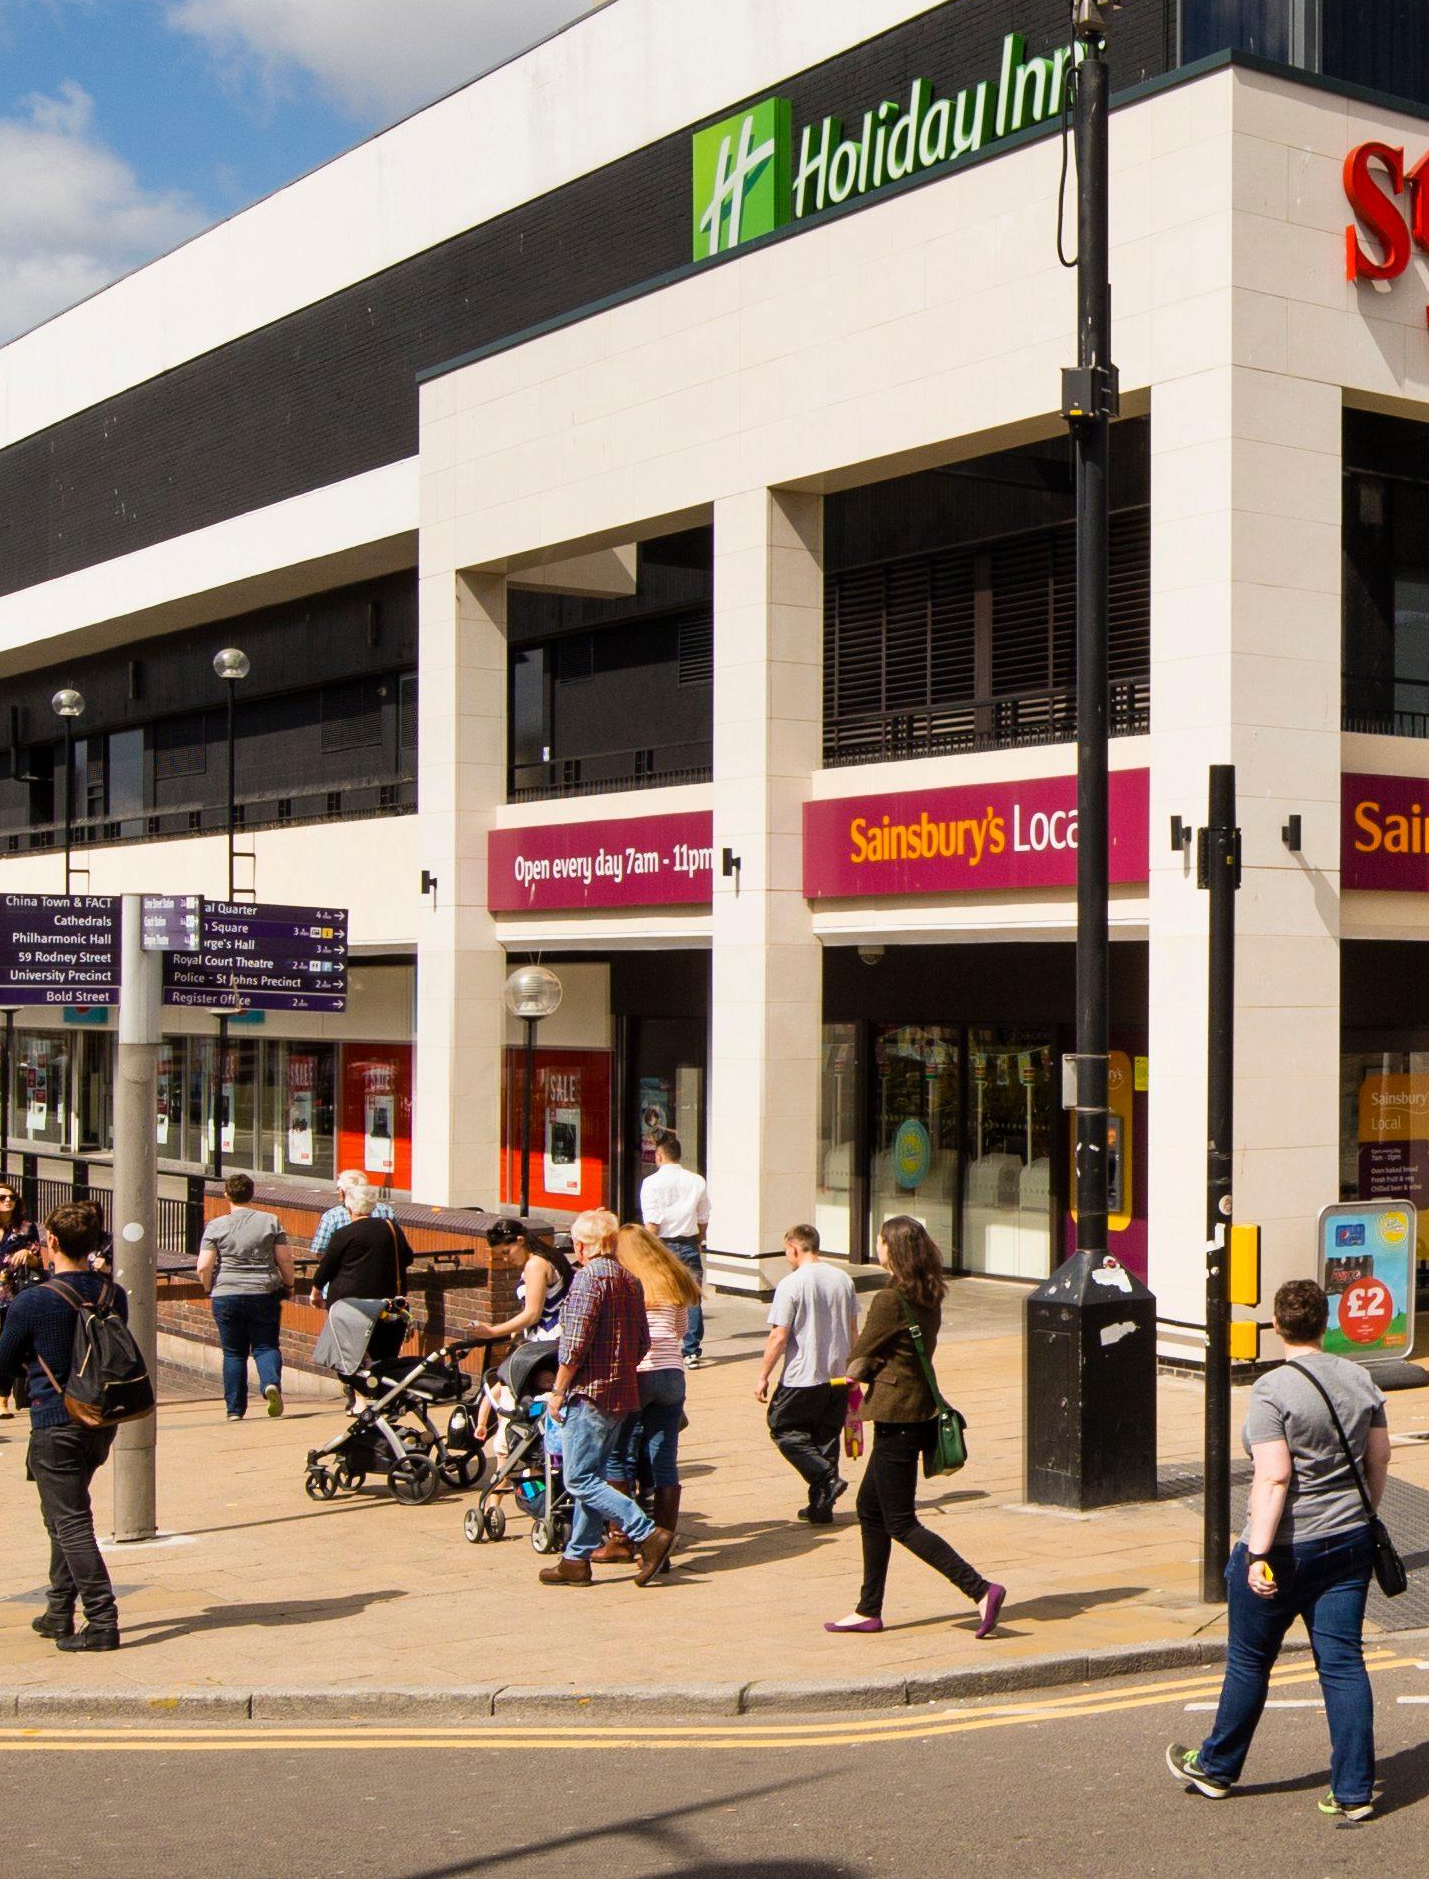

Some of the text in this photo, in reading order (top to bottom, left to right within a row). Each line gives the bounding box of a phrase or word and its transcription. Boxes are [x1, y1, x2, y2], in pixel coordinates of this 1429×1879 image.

[792, 76, 988, 219] Holiday
[850, 804, 1079, 867] Sainsbury's Loca
[514, 856, 549, 887] Open
[553, 856, 592, 885] every
[595, 848, 622, 883] day
[625, 848, 659, 874] 7am
[673, 843, 713, 878] 11pm
[6, 896, 112, 908] China Town & FACT
[218, 904, 258, 915] Quarter
[54, 915, 112, 926] Cathedrals
[212, 923, 249, 934] Square
[294, 927, 299, 936] 3
[12, 932, 87, 944] Philharmonic
[90, 934, 112, 944] Hall
[234, 940, 255, 950] Hall
[19, 953, 31, 962] 59
[35, 952, 77, 964] Rodney
[79, 953, 112, 963] Street
[173, 953, 202, 966] Royal
[205, 955, 233, 967] Court
[236, 957, 274, 969] Theatre
[292, 961, 298, 969] 2
[10, 970, 65, 982] University
[68, 971, 112, 981] Precinct
[174, 971, 205, 983] Police
[216, 973, 226, 984] St
[229, 974, 258, 986] Johns
[261, 975, 301, 987] Precinct
[46, 991, 72, 1001] Bold
[76, 992, 109, 1002] Street
[172, 992, 217, 1005] Register
[292, 999, 298, 1007] 2
[550, 1074, 576, 1103] SALE
[1372, 1115, 1401, 1130] Local
[1347, 1286, 1385, 1318] £2
